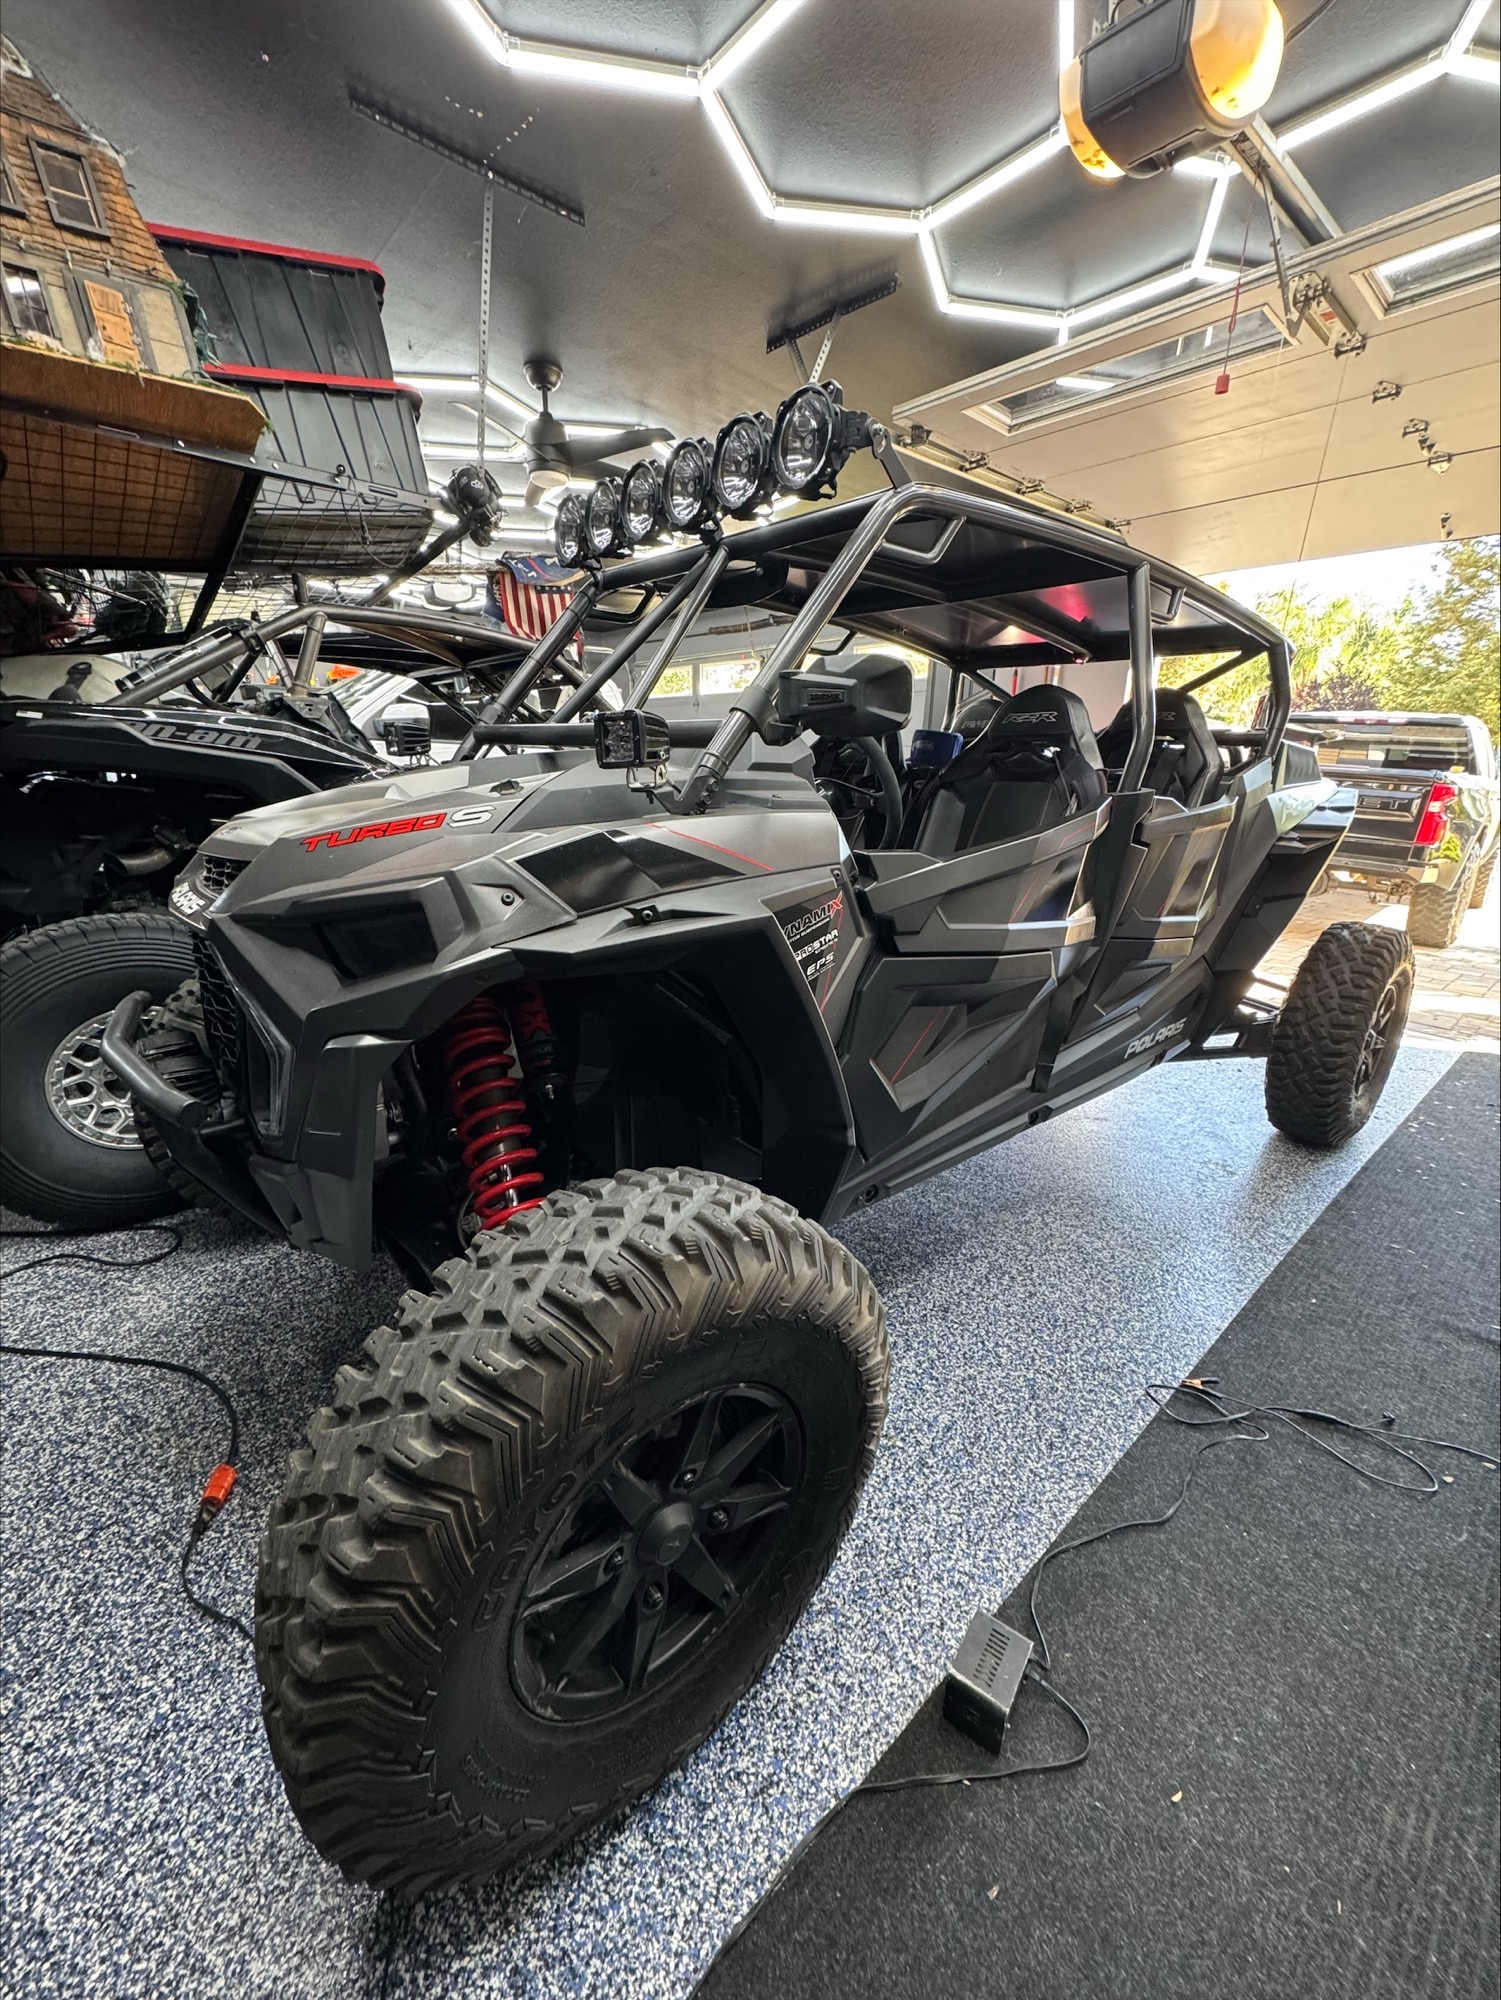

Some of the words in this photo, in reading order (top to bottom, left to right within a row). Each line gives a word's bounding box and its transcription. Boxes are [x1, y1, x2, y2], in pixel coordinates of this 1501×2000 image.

[122, 719, 263, 750] an-am
[1002, 711, 1058, 724] RZR
[300, 812, 448, 853] TURBO
[446, 804, 497, 829] S
[783, 889, 843, 940] YNAMIX
[806, 951, 835, 976] EPS
[1123, 1016, 1188, 1060] POLARIS
[472, 1403, 640, 1633] COYOTE
